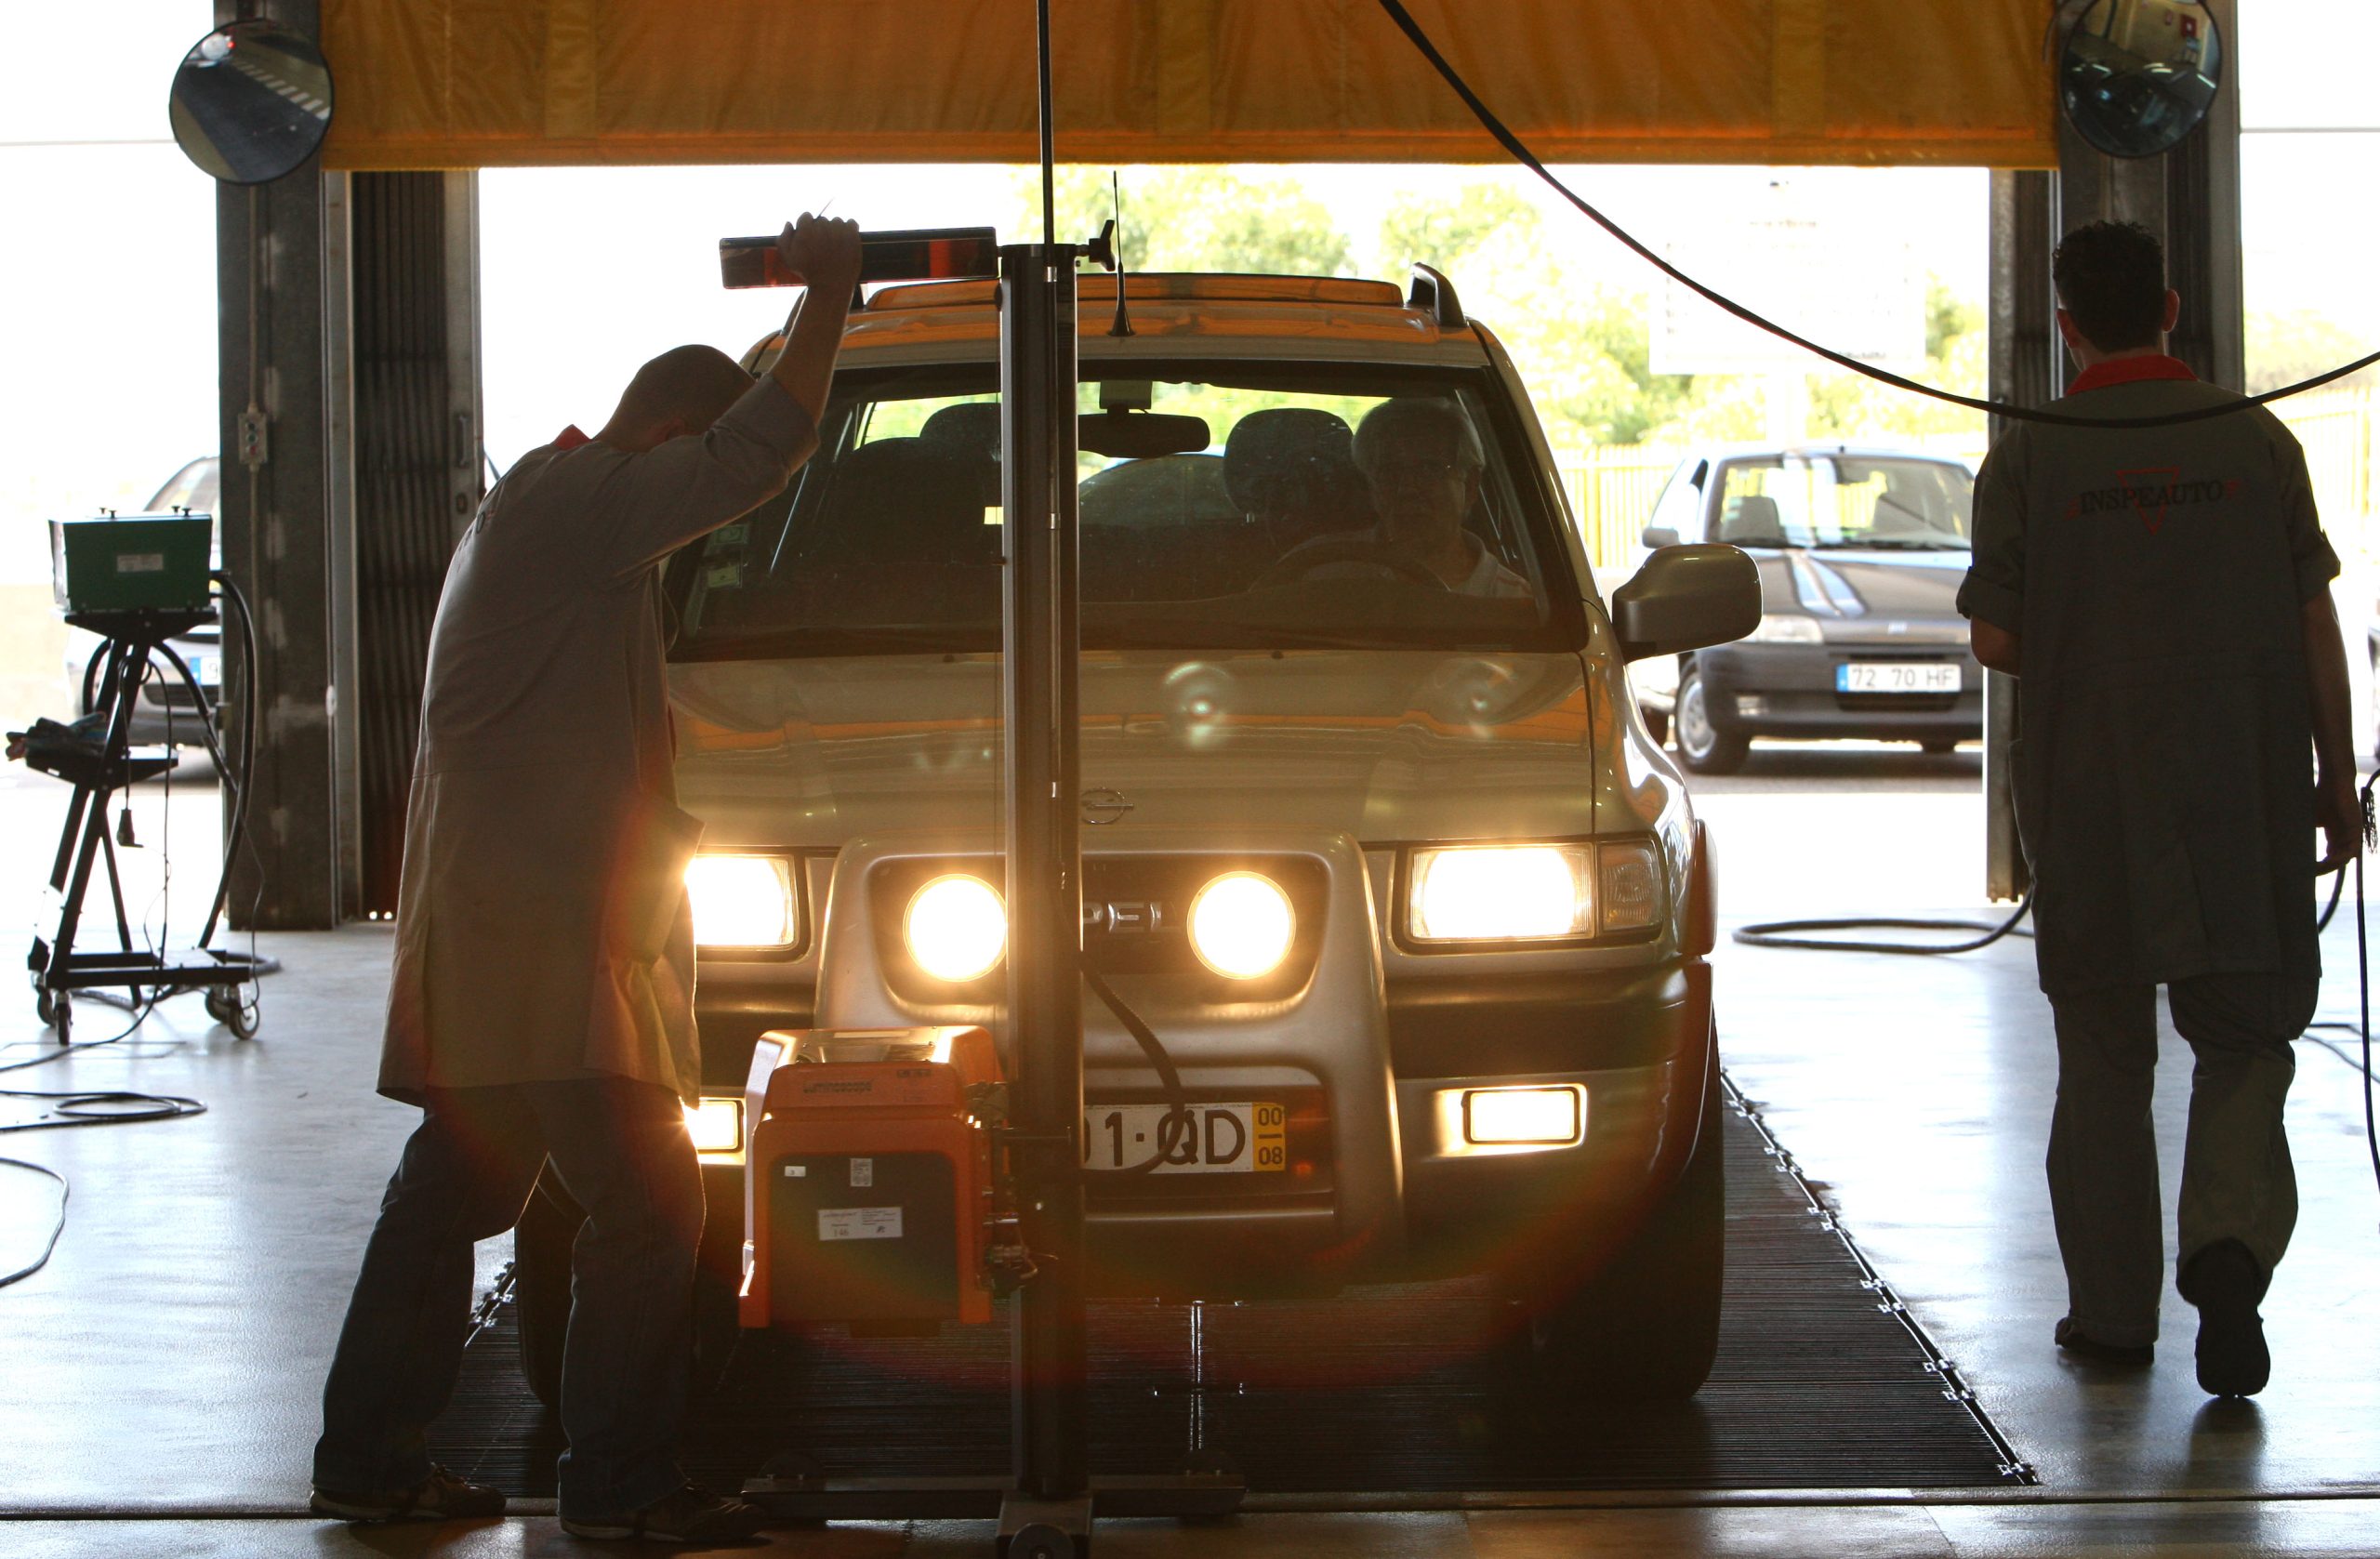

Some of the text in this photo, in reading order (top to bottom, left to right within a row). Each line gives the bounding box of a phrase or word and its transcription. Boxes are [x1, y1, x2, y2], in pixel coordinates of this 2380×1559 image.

[2080, 479, 2225, 514] INSPEAUTO
[1851, 667, 1955, 687] 72 70 HF
[1258, 1106, 1283, 1127] 00
[1258, 1145, 1284, 1166] 08
